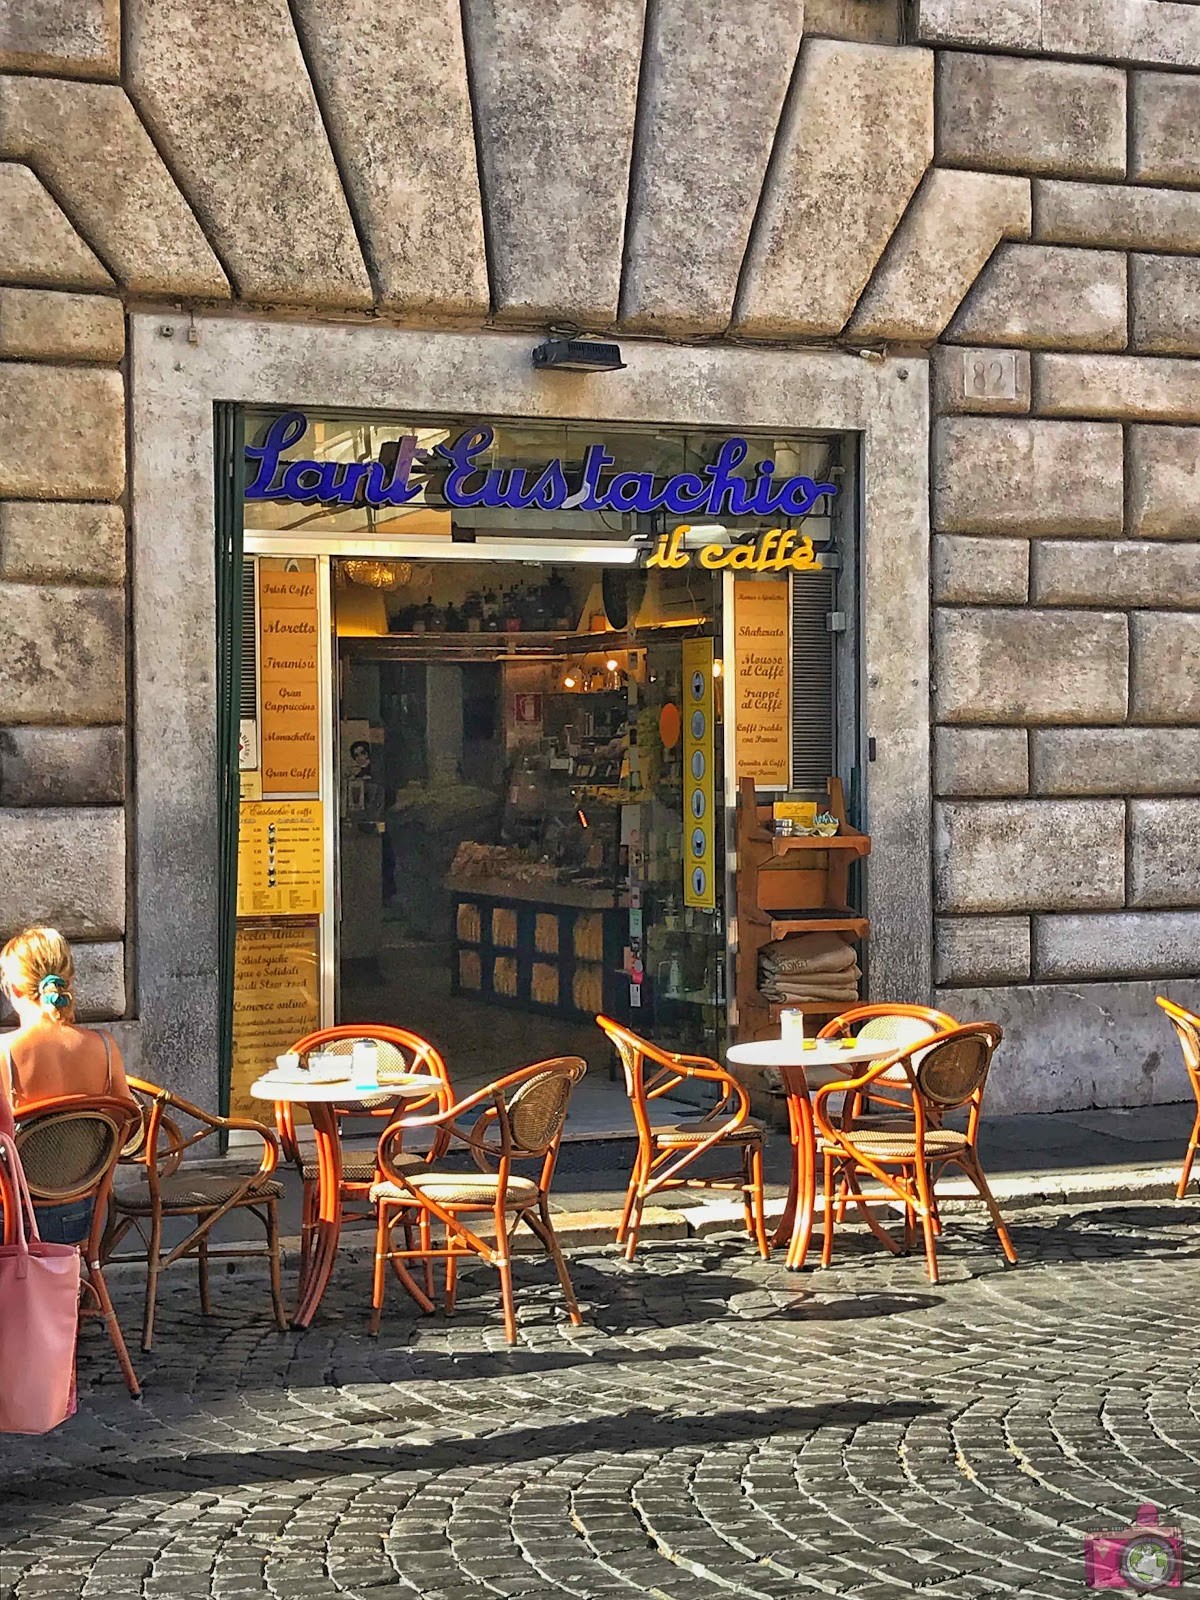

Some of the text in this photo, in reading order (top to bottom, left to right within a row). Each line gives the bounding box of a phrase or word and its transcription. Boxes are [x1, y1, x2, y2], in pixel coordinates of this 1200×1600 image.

[972, 360, 1006, 391] 82
[436, 424, 838, 517] Eustachio
[645, 524, 823, 574] il caffè
[263, 583, 287, 595] Irish
[263, 619, 317, 634] Moretto
[738, 625, 785, 638] Shakerato
[263, 655, 316, 670] Tiramisù
[741, 652, 783, 665] Mousse
[740, 665, 753, 677] al
[278, 687, 302, 699] Gran
[264, 701, 316, 714] Cappuccino
[741, 699, 753, 709] al
[265, 767, 289, 779] Gran
